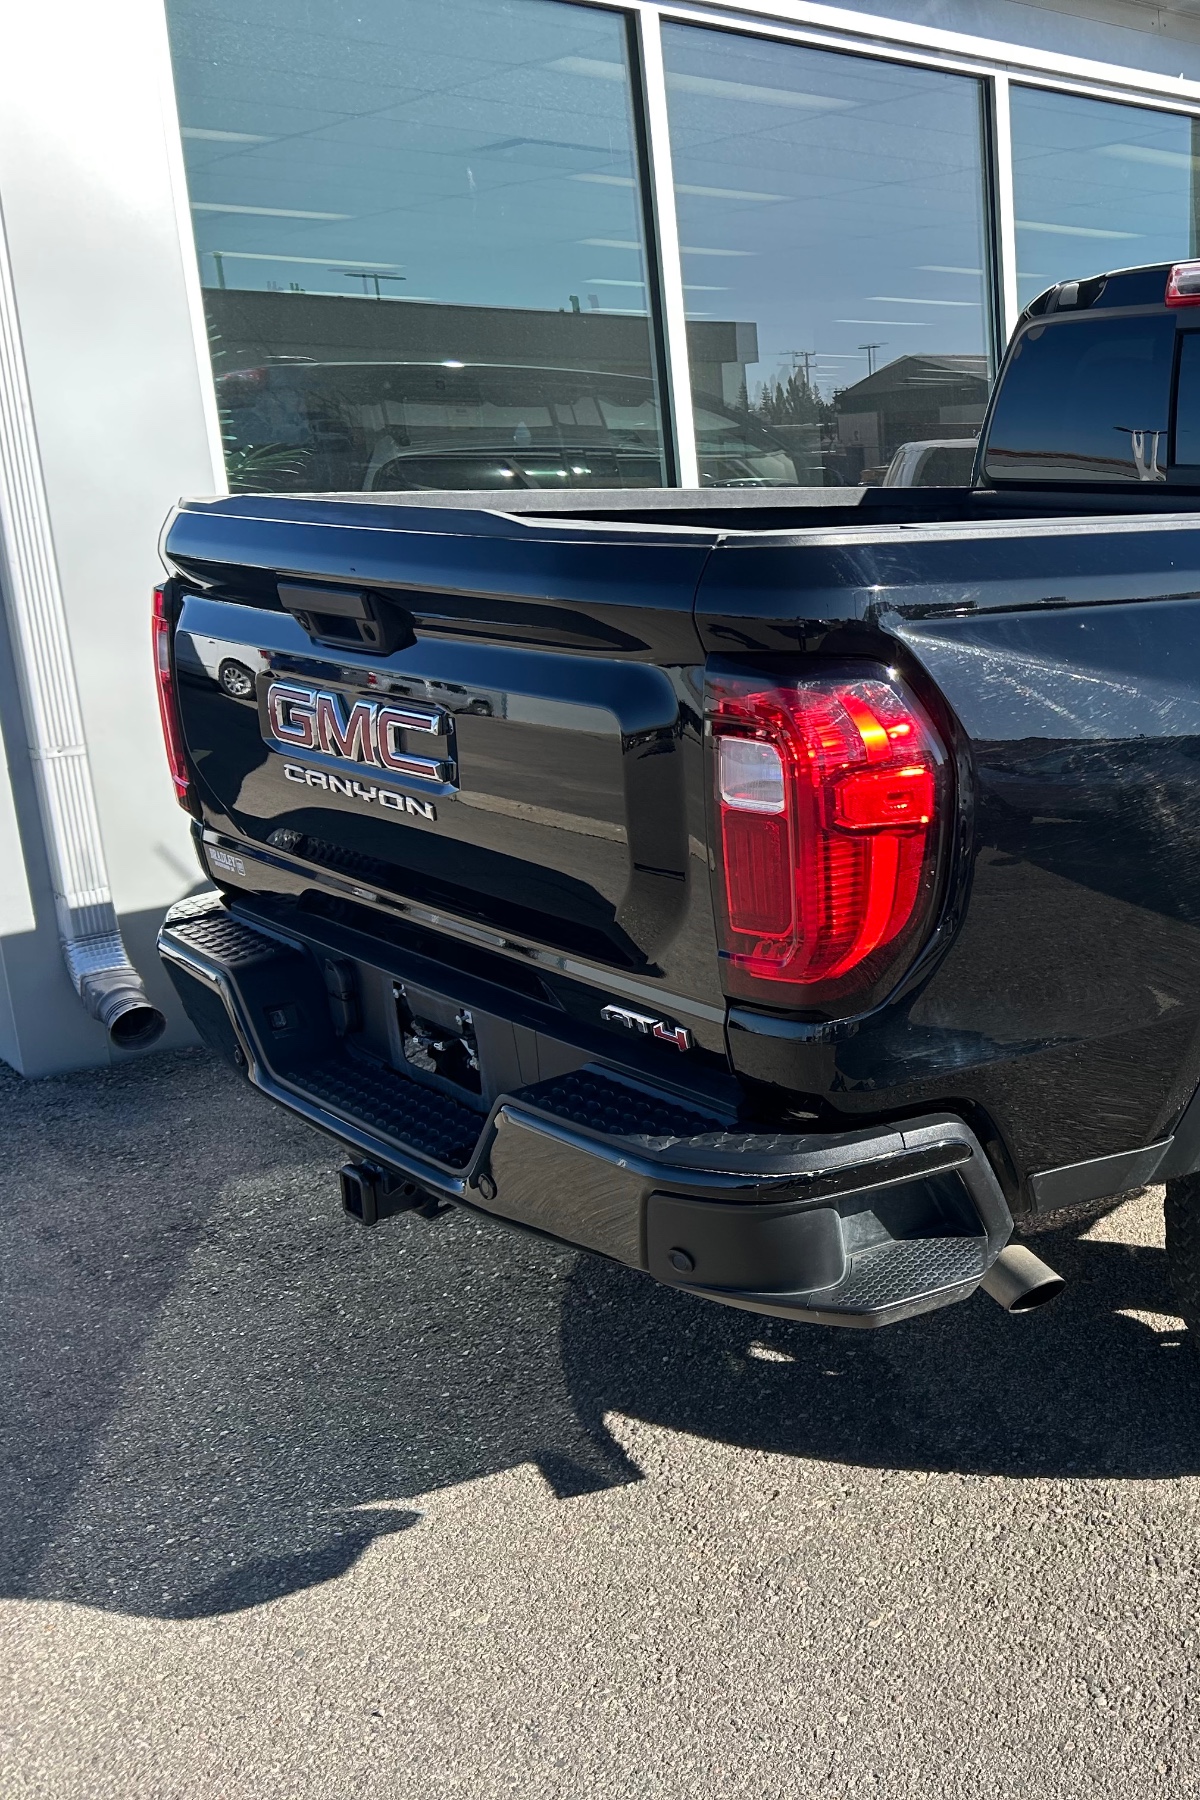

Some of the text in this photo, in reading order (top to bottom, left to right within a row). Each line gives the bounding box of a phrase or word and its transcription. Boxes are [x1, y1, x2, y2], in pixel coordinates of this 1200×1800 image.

[268, 683, 449, 784] GMC
[284, 763, 437, 822] CANYON
[600, 1004, 691, 1053] AT4
